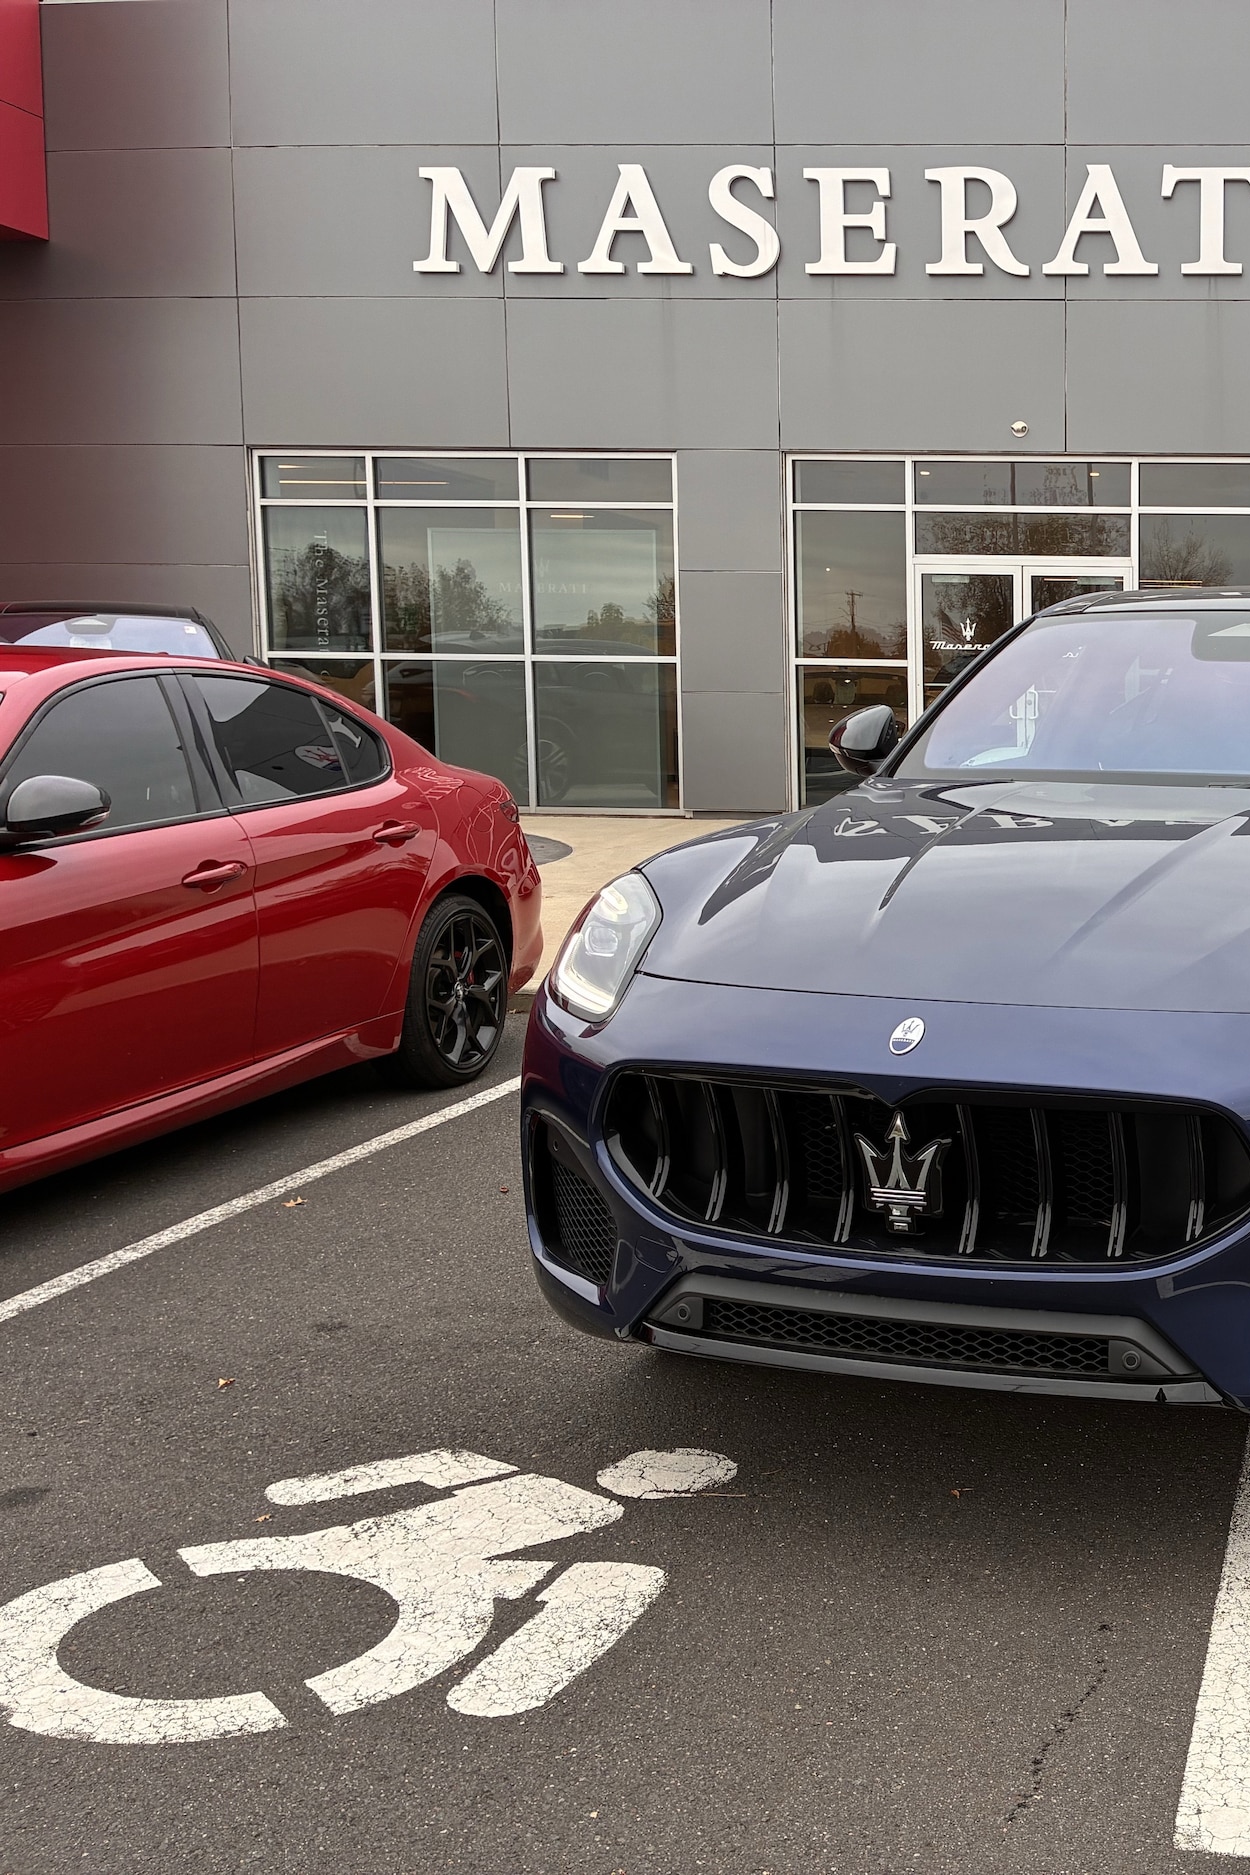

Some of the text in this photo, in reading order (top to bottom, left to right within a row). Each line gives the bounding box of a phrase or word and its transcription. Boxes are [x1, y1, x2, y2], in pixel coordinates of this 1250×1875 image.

[313, 530, 328, 568] The
[499, 582, 588, 594] MAERATI
[315, 578, 331, 652] Masera
[929, 640, 991, 650] Masera
